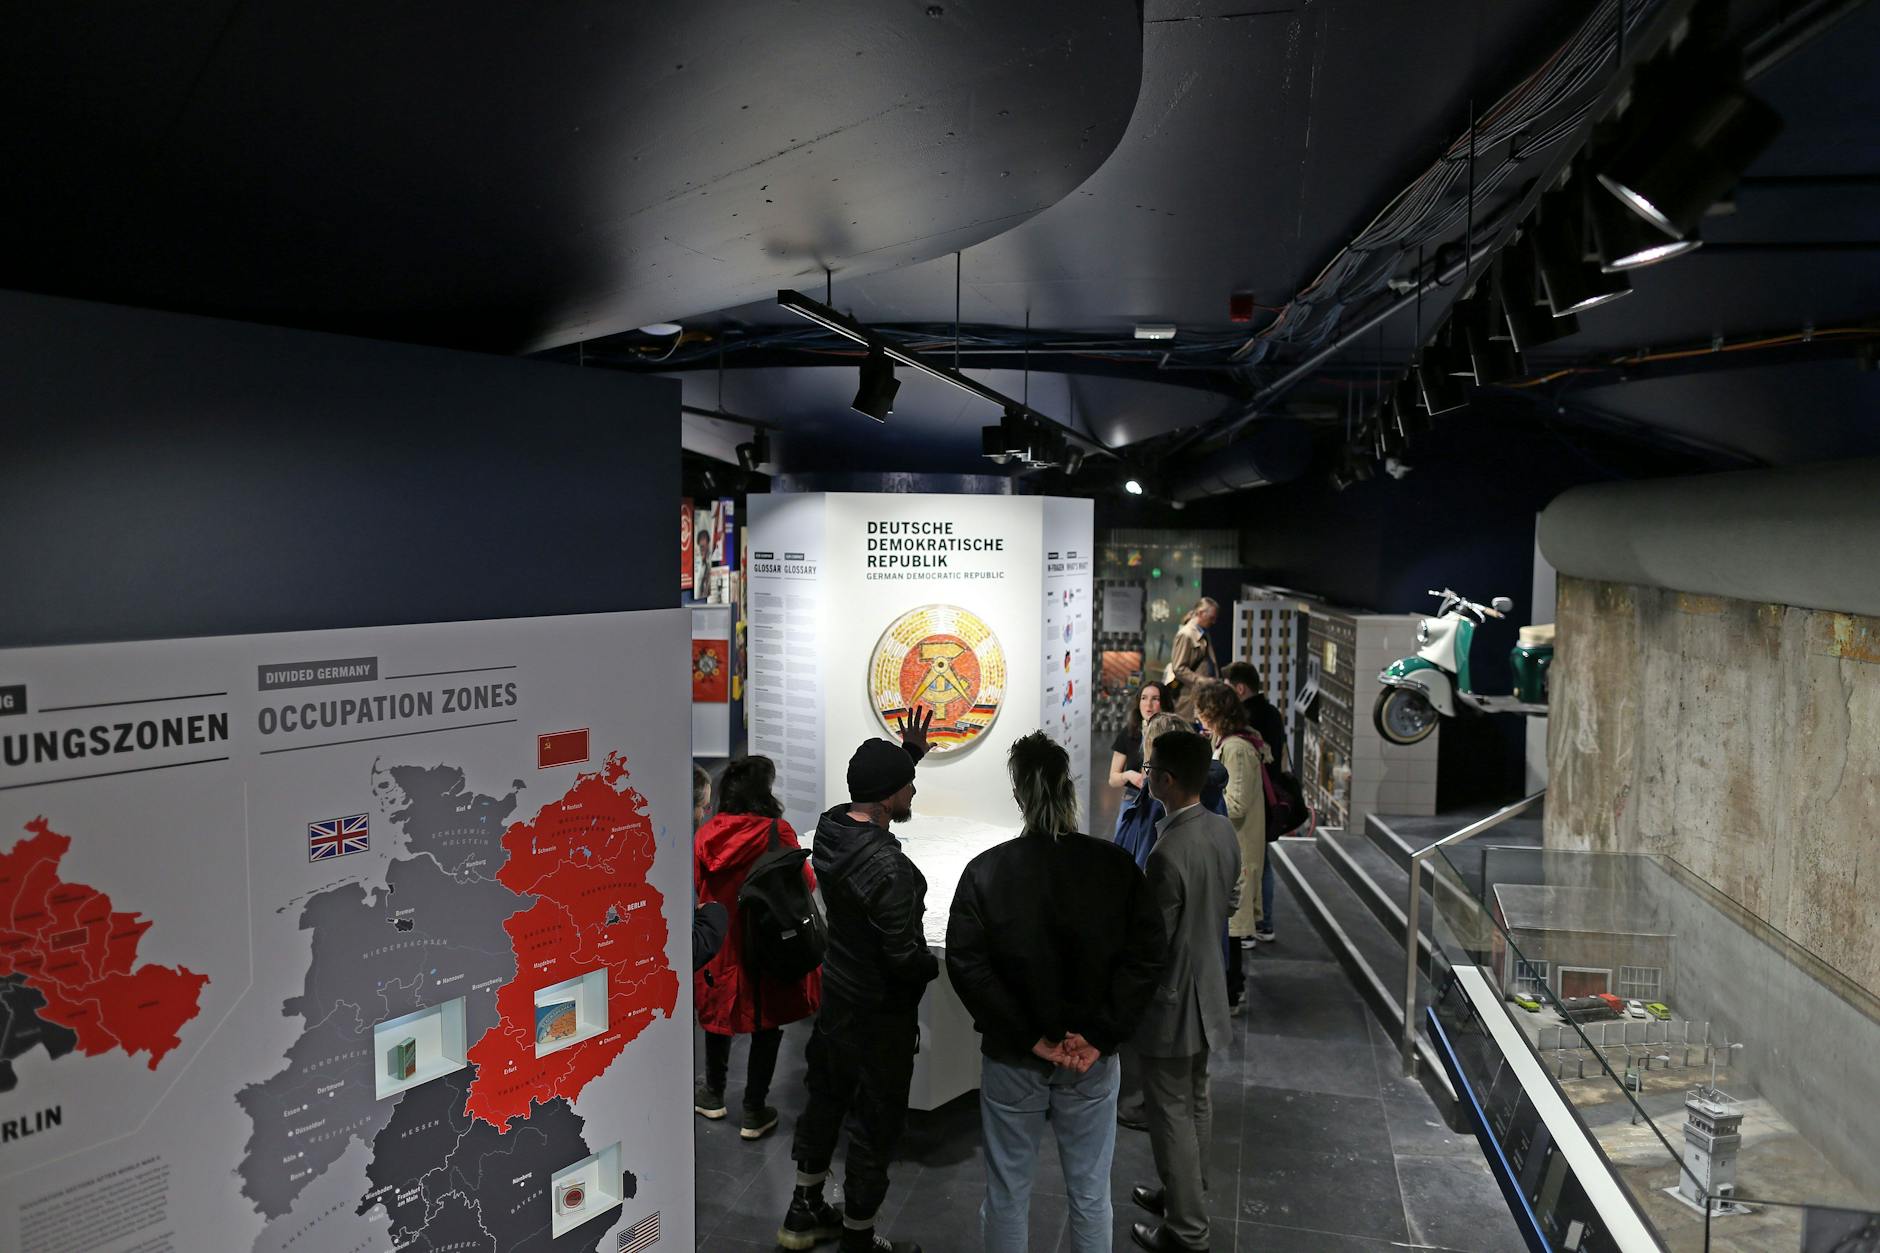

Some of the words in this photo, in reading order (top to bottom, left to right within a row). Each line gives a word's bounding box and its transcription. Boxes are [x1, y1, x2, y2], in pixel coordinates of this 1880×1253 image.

[867, 521, 954, 535] DEUTSCHE
[867, 538, 1004, 552] DEMOKRATISCHE
[867, 554, 948, 568] REPUBLIK
[754, 564, 781, 573] GLOSSAR
[784, 565, 816, 574] GLOSSARY
[866, 572, 904, 581] GERMAN
[906, 572, 961, 580] DEMOCRATIC
[964, 571, 1005, 580] REPUBLIC
[266, 670, 314, 684] DIVIDED
[317, 664, 370, 679] GERMANY
[258, 691, 433, 735] OCCUPATION
[441, 682, 518, 714] ZONES
[442, 838, 489, 848] HOLSTEIN
[627, 900, 647, 911] BERLIN
[362, 938, 448, 960] NIEDERSACHSEN
[503, 1065, 518, 1075] Erfurt
[316, 1079, 345, 1095] Dortmund
[283, 1107, 301, 1118] Essen
[295, 1117, 327, 1135] Düsseldorf
[309, 1115, 371, 1144] WESTFALEN
[401, 1119, 440, 1138] HESSEN
[397, 1186, 421, 1201] Frankfurt
[510, 1189, 543, 1215] BAYERN
